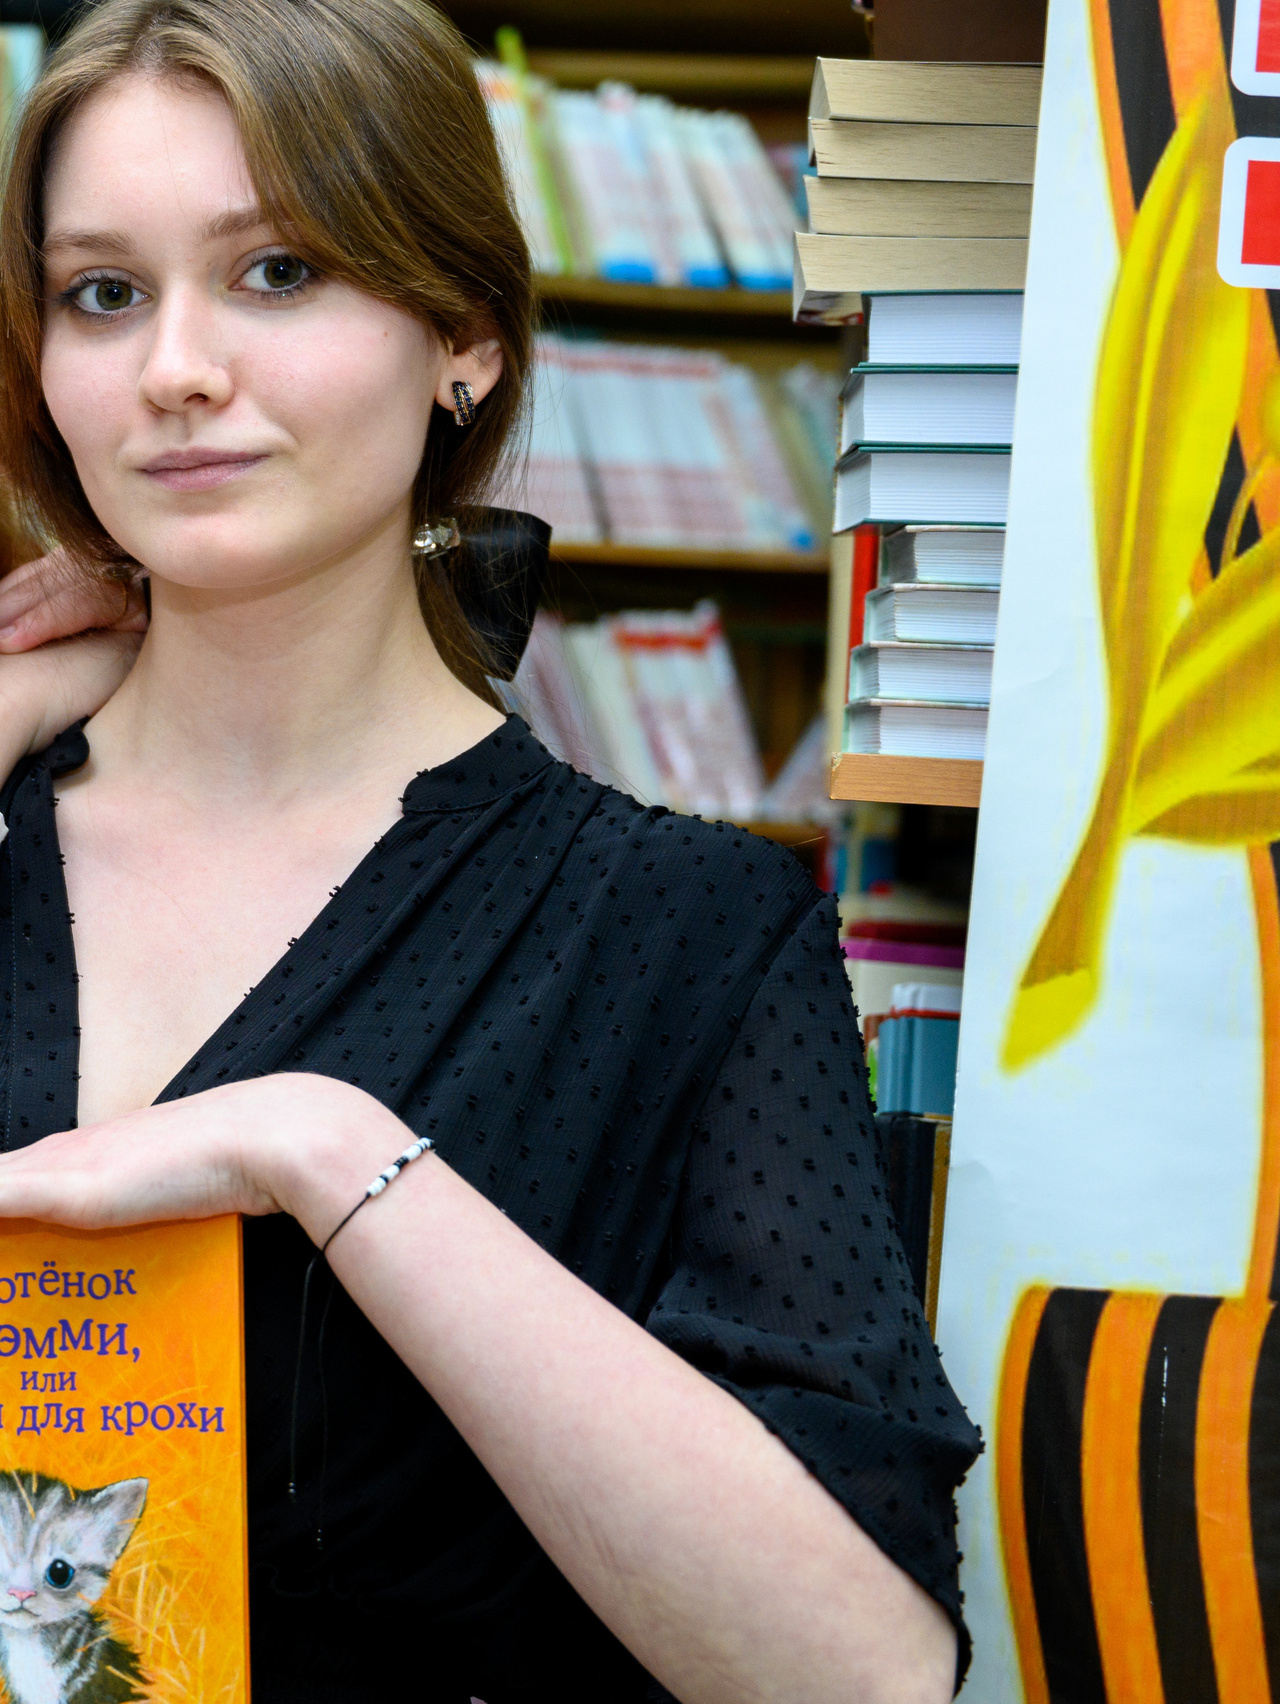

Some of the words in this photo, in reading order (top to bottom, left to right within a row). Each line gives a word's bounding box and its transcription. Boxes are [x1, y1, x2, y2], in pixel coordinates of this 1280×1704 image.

[20, 1370, 77, 1393] или
[16, 1401, 85, 1436] для
[100, 1400, 225, 1436] крохи
